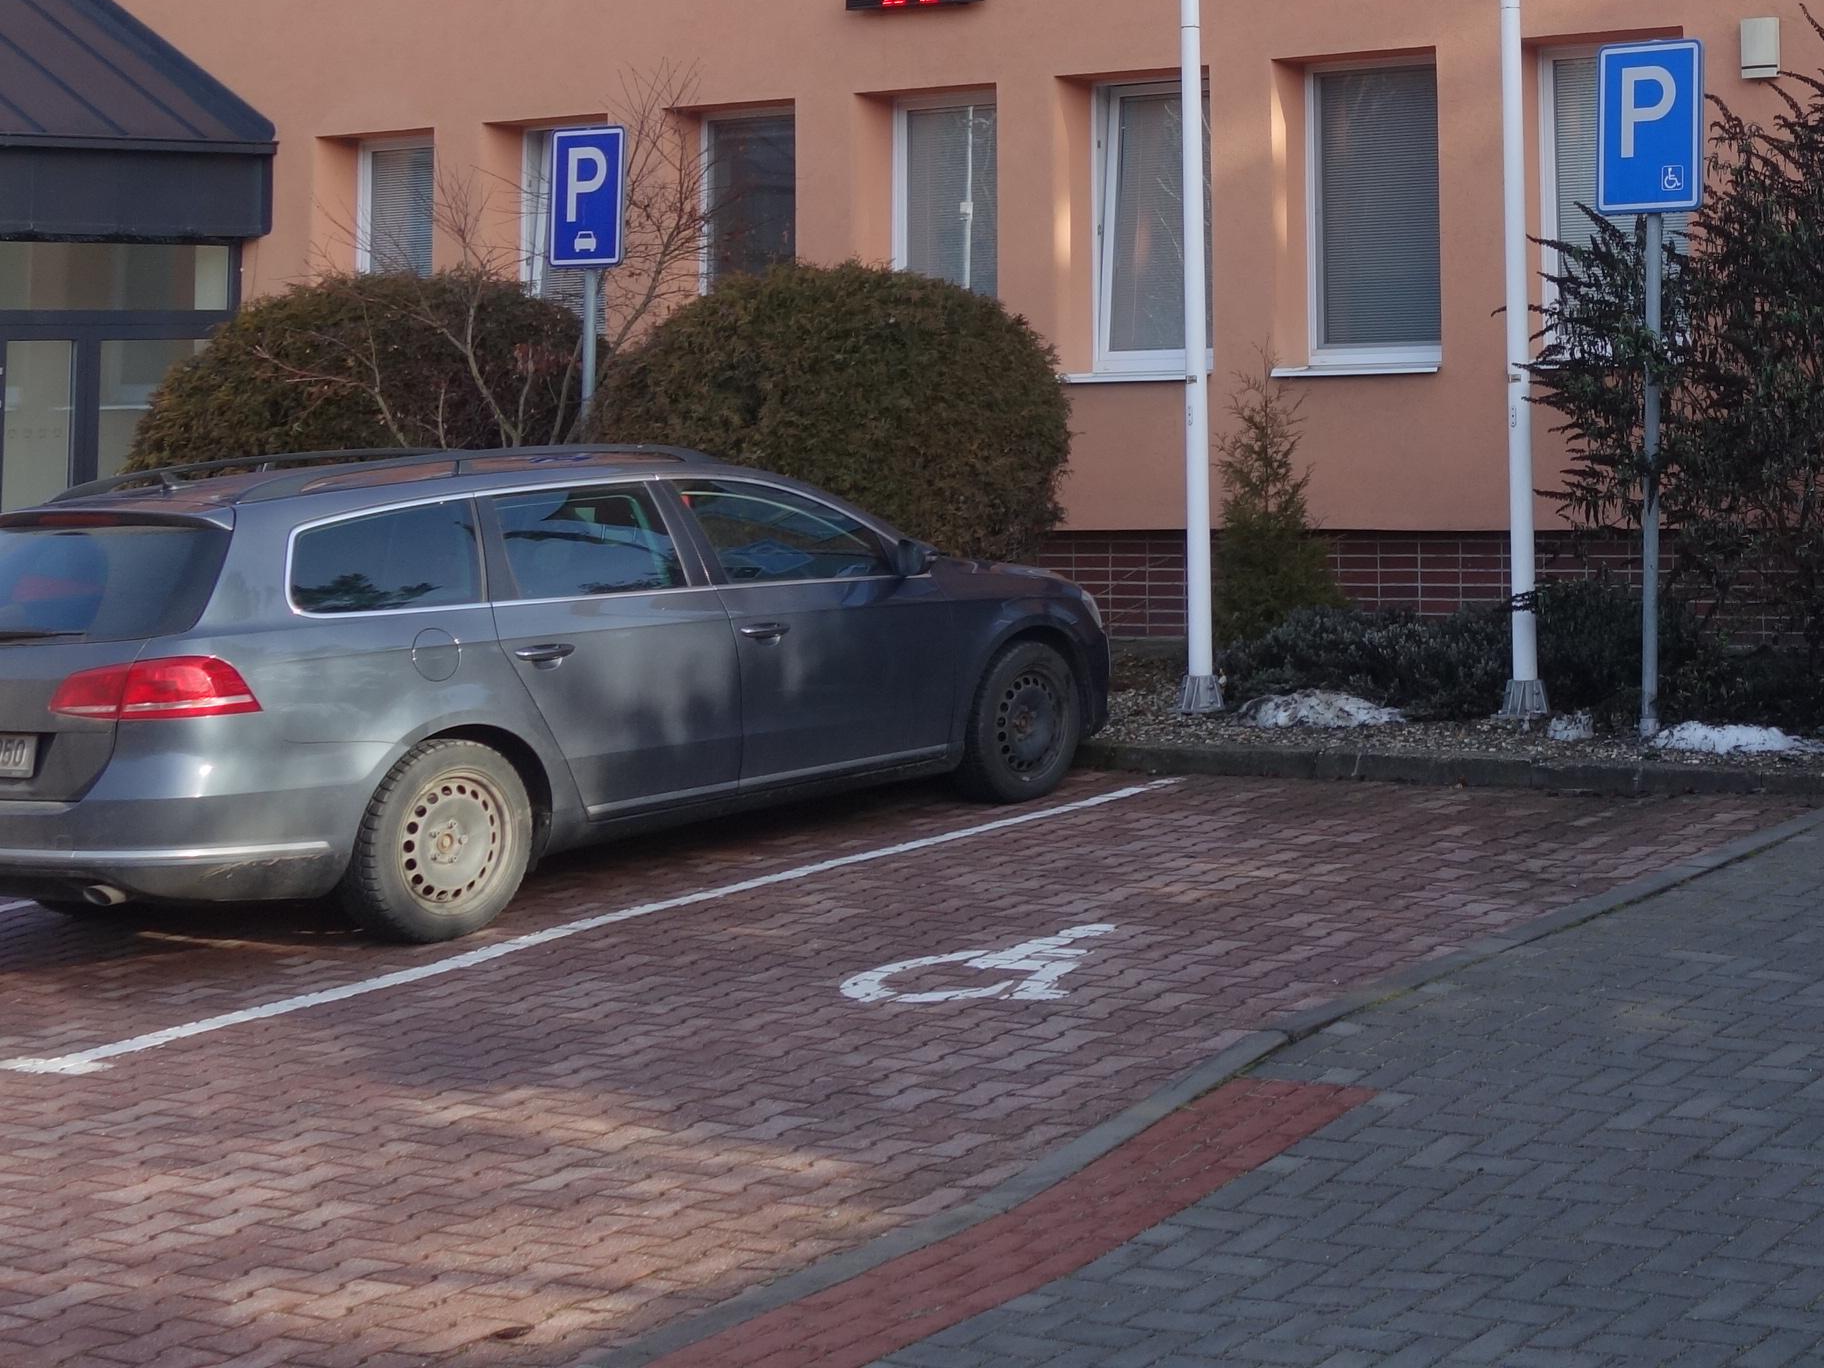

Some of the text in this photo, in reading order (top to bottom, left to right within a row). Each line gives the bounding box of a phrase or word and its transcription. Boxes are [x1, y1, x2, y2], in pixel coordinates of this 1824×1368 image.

[1620, 65, 1677, 159] P
[566, 146, 607, 223] P
[0, 738, 25, 766] 50
